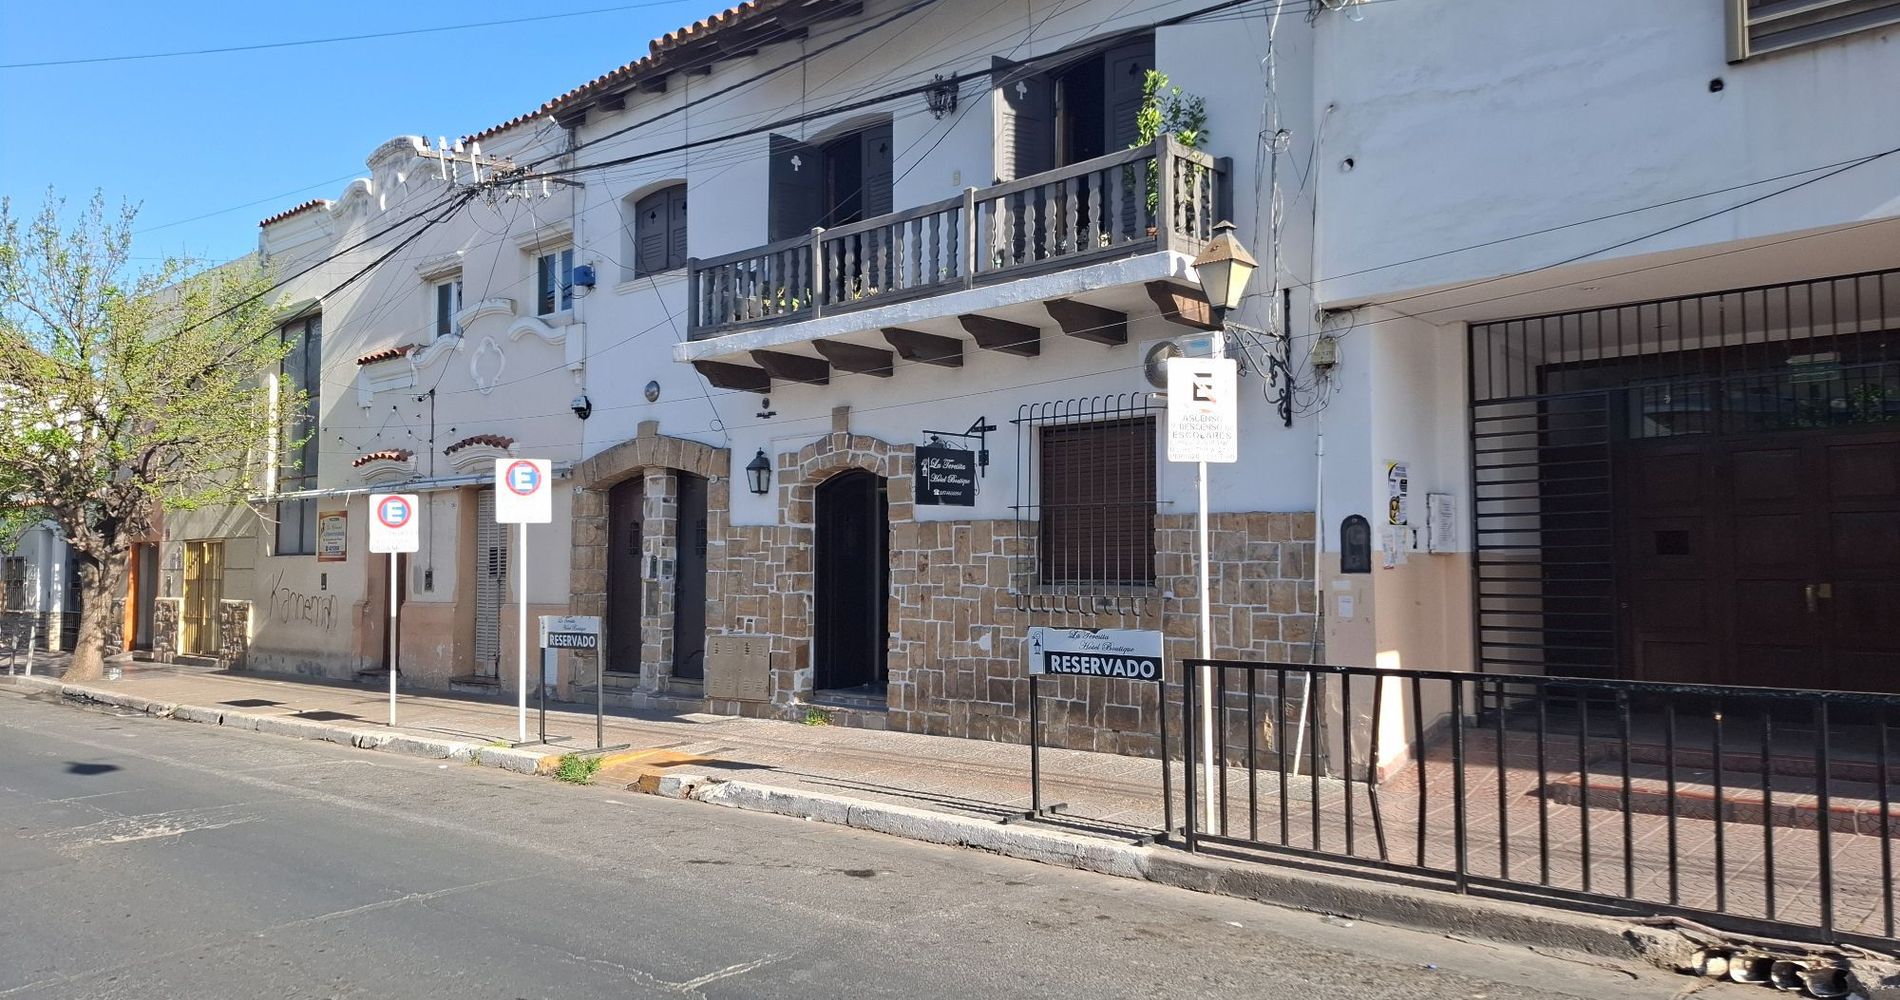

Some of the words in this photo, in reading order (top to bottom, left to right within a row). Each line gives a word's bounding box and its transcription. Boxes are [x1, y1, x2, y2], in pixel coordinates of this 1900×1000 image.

[515, 466, 533, 489] E
[387, 502, 402, 522] E
[549, 634, 596, 648] RESERVADO
[1050, 654, 1156, 679] RESERVADO
